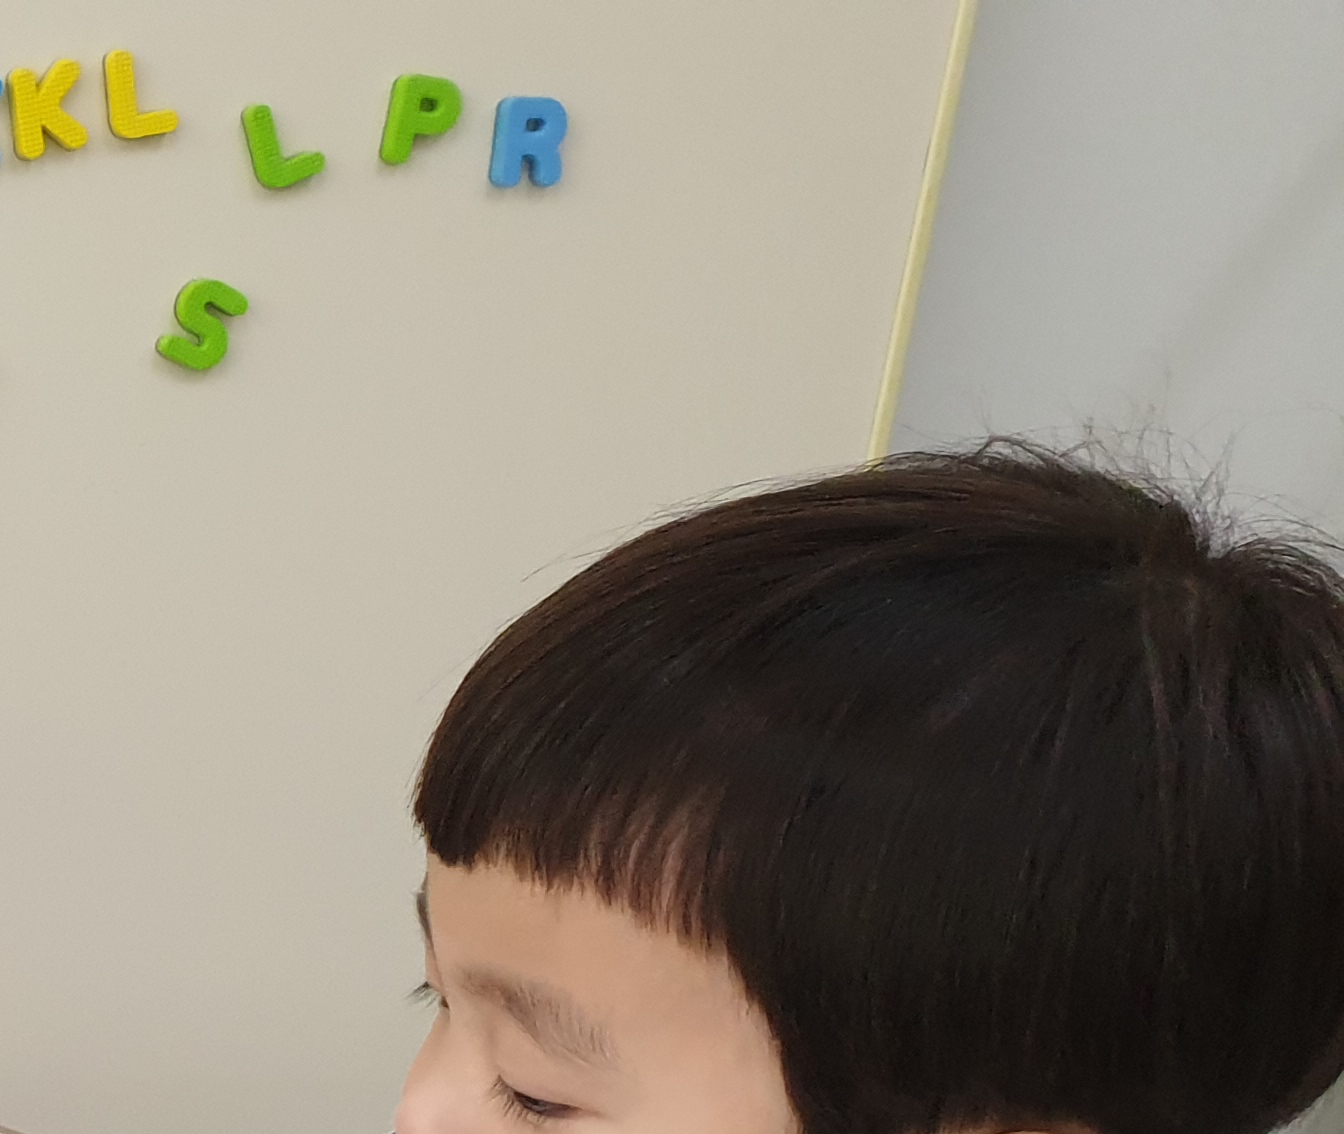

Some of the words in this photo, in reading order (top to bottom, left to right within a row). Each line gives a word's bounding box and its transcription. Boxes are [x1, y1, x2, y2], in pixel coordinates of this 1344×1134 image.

[240, 104, 326, 191] L
[378, 73, 464, 167] P
[489, 96, 569, 188] R
[155, 278, 250, 373] S
